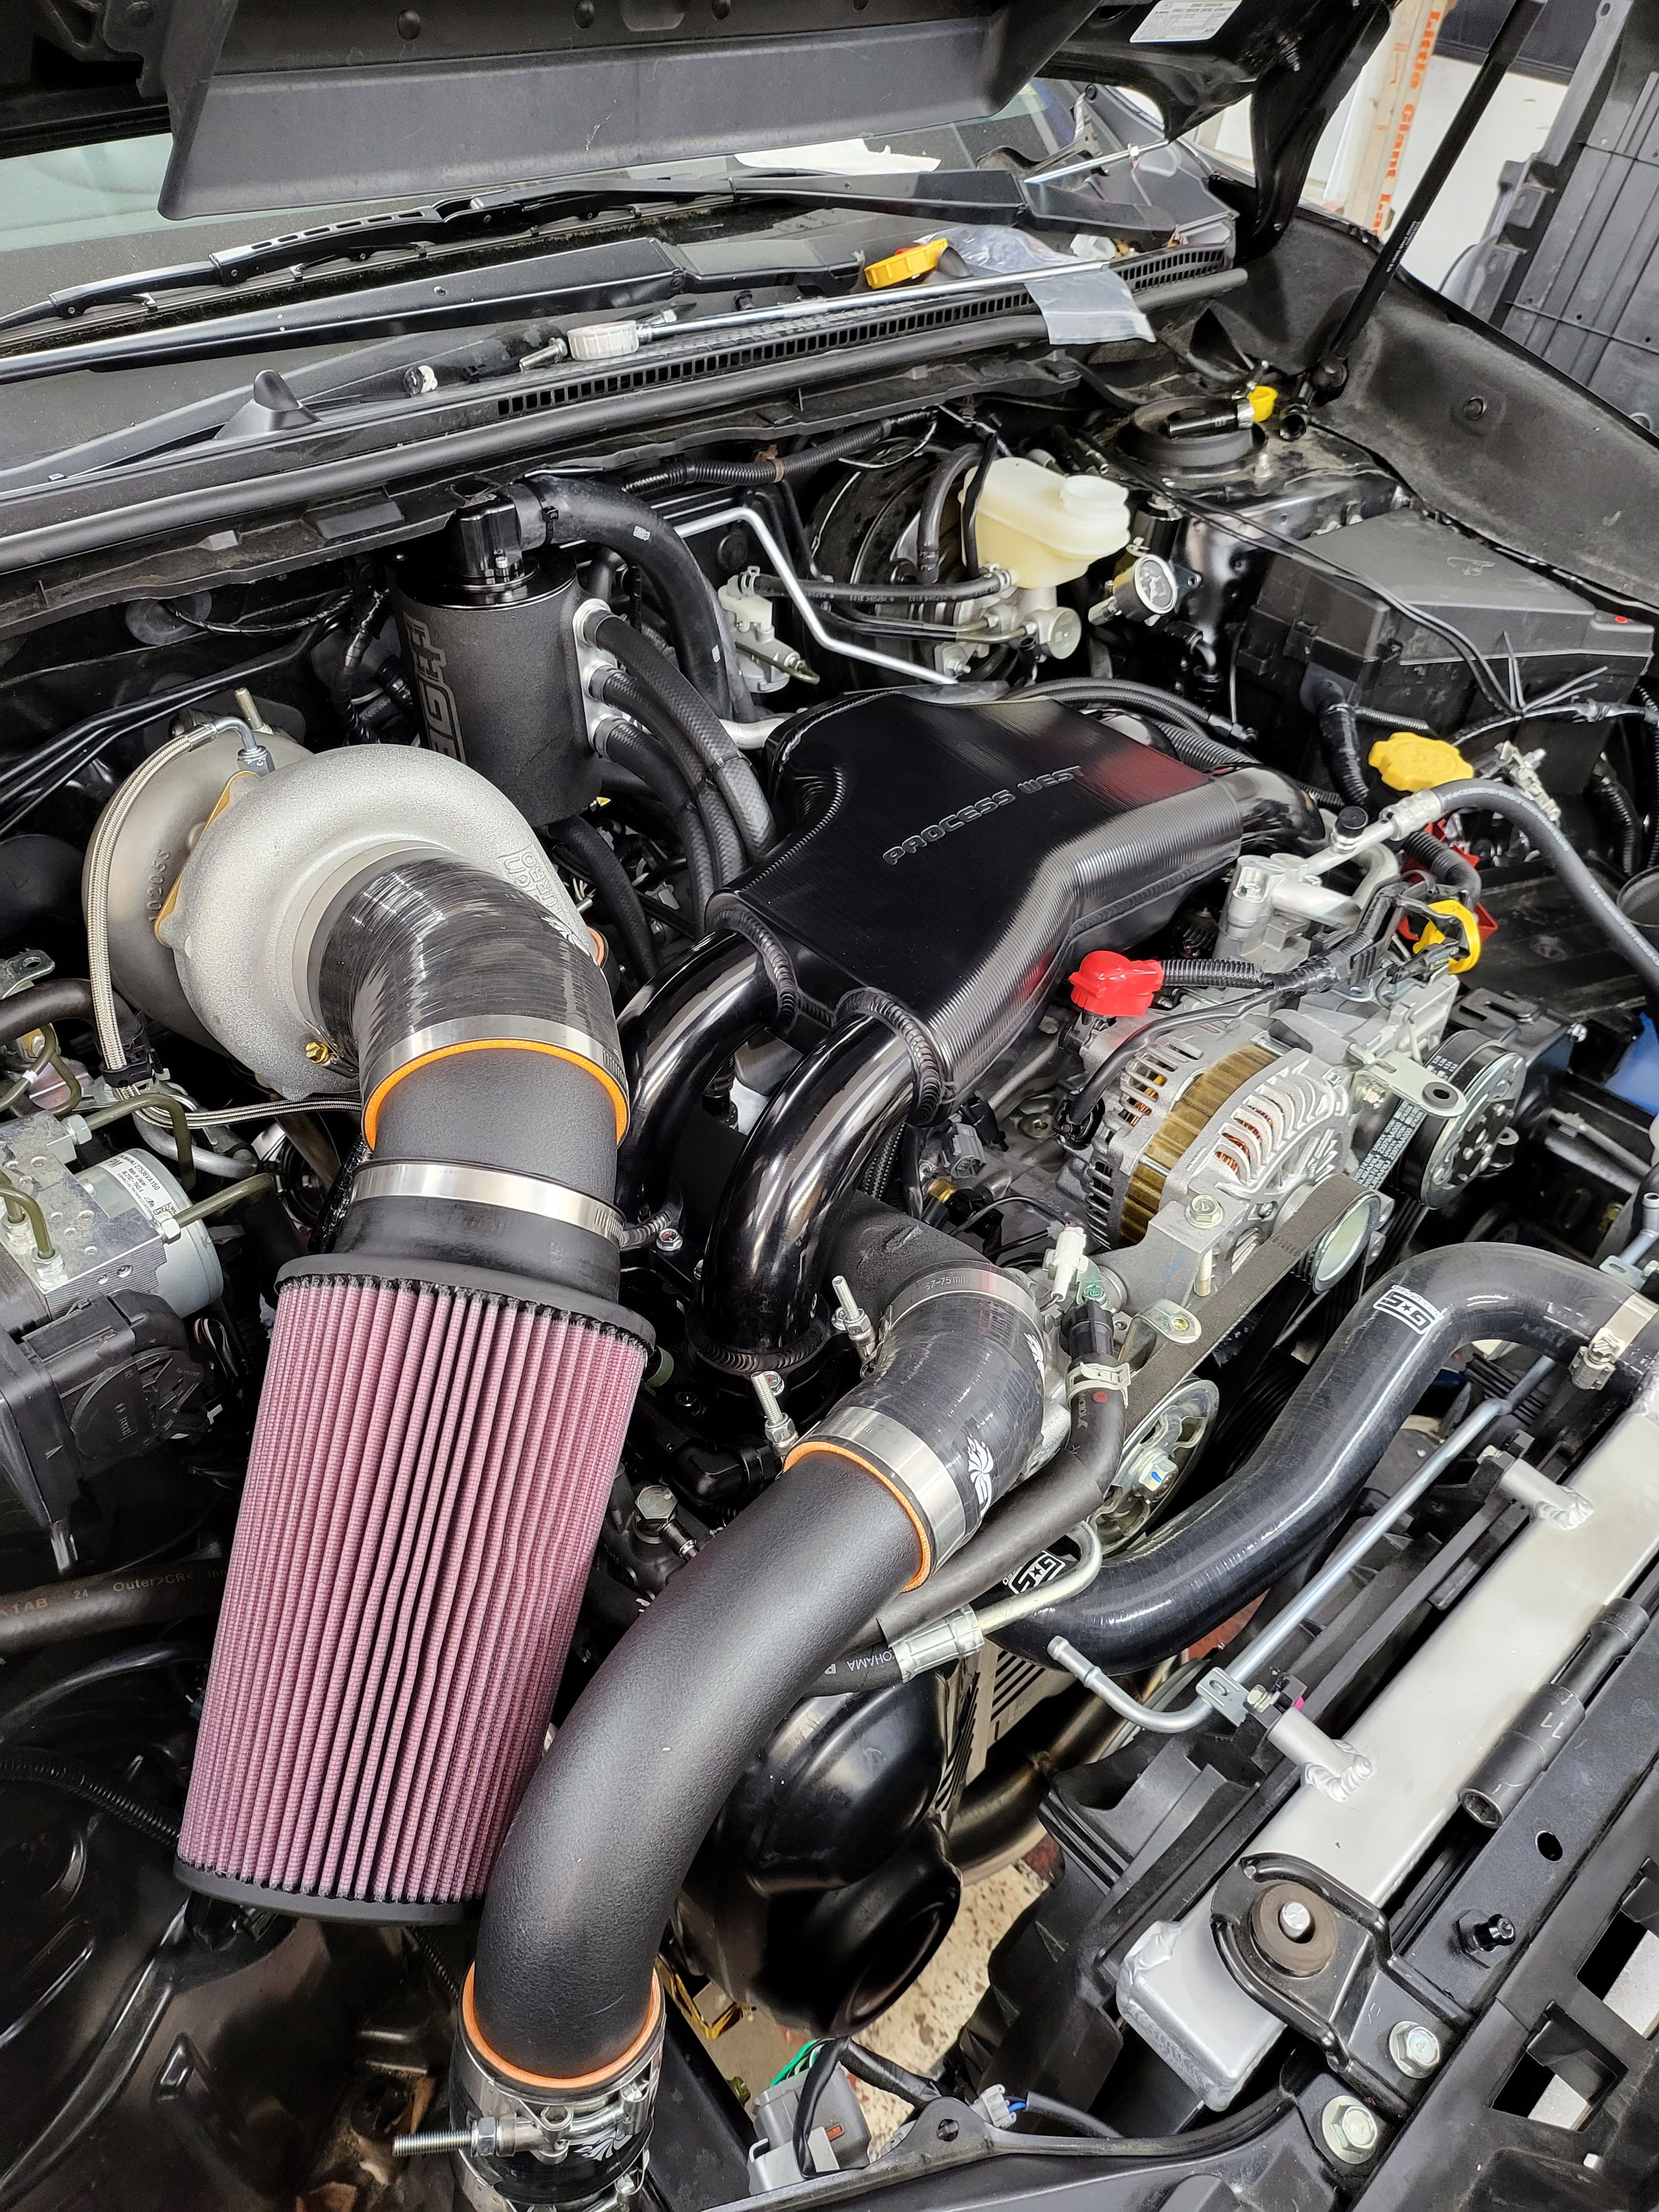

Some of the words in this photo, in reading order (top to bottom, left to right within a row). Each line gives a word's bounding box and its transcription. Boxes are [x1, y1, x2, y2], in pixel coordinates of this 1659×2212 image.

[1410, 10, 1441, 88] Little
[1386, 103, 1415, 179] Giant
[882, 789, 1017, 867] PROCESS
[1017, 765, 1086, 796] WEST
[134, 1164, 160, 1191] 27536VA150
[74, 1588, 90, 1600] 24
